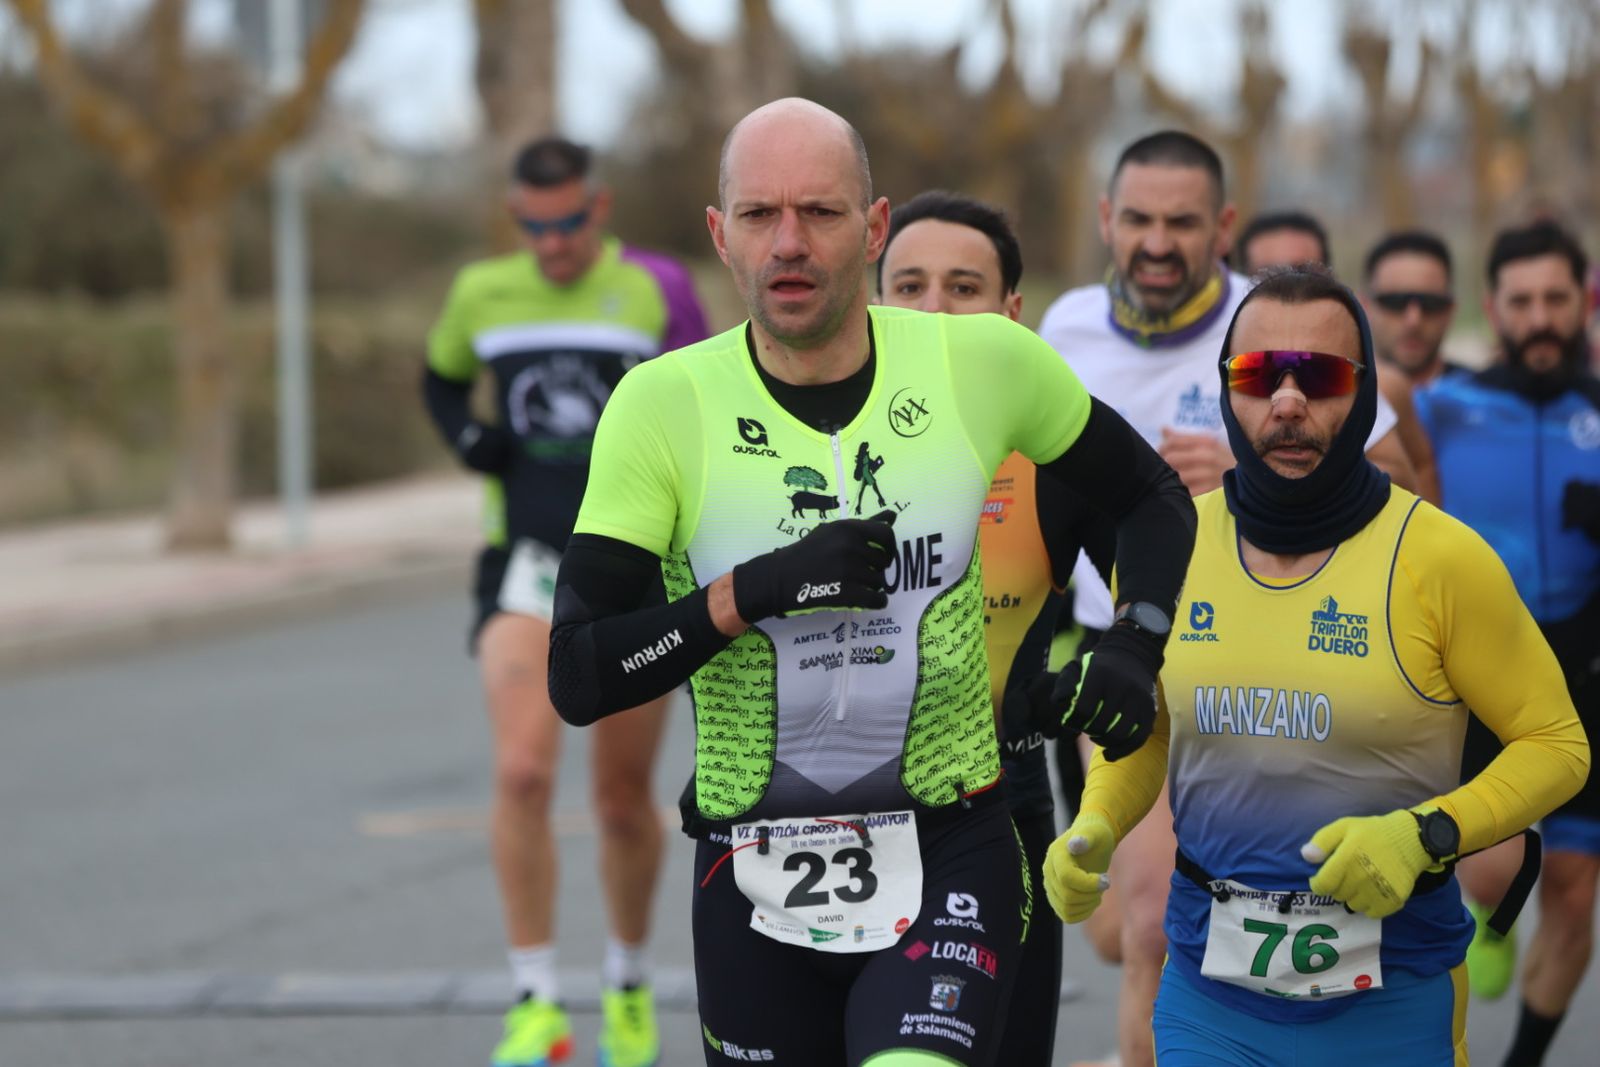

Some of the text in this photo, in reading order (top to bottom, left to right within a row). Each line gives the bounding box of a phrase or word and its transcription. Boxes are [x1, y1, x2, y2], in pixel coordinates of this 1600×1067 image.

[776, 517, 795, 536] La
[810, 582, 841, 598] asics
[861, 626, 902, 637] TELECO
[868, 617, 895, 627] AZUL
[793, 632, 829, 645] AMTEL
[1308, 635, 1369, 658] DUERO
[621, 628, 683, 673] KIPRUN
[1195, 686, 1332, 742] MANZANO
[737, 826, 751, 840] VI
[802, 824, 838, 836] CROSS
[783, 847, 878, 909] 23
[817, 914, 844, 924] DAVID
[934, 917, 985, 933] austral
[1243, 918, 1340, 977] 76
[902, 1012, 976, 1037] Ayuntamiento
[900, 1022, 973, 1049] de Salamanca
